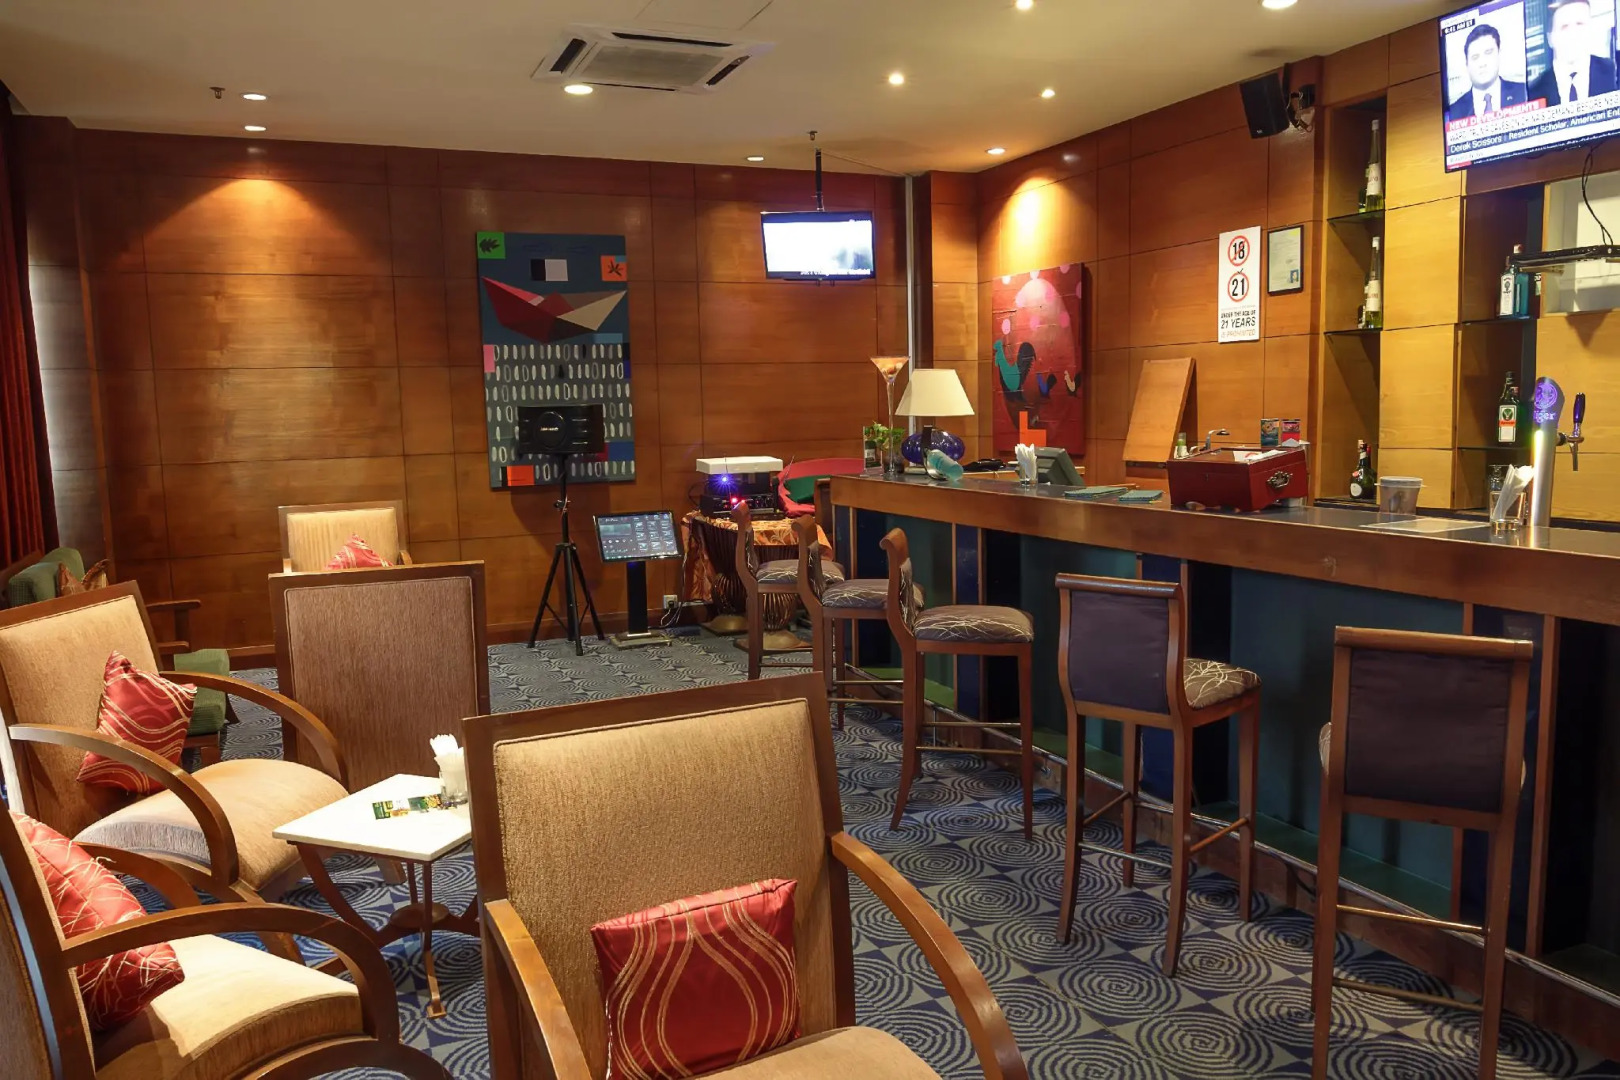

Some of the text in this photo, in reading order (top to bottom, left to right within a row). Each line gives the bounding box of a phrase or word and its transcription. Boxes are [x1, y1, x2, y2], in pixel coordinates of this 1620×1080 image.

[1450, 118, 1469, 131] NEW
[1470, 101, 1540, 126] DEVELOPMENTS
[1450, 141, 1471, 153] Derek
[1472, 135, 1502, 148] Scissors
[1508, 127, 1539, 140] Resident
[1570, 112, 1606, 127] American
[1232, 241, 1245, 260] 18
[1231, 278, 1245, 296] 21
[1220, 316, 1256, 329] 21 YEARS
